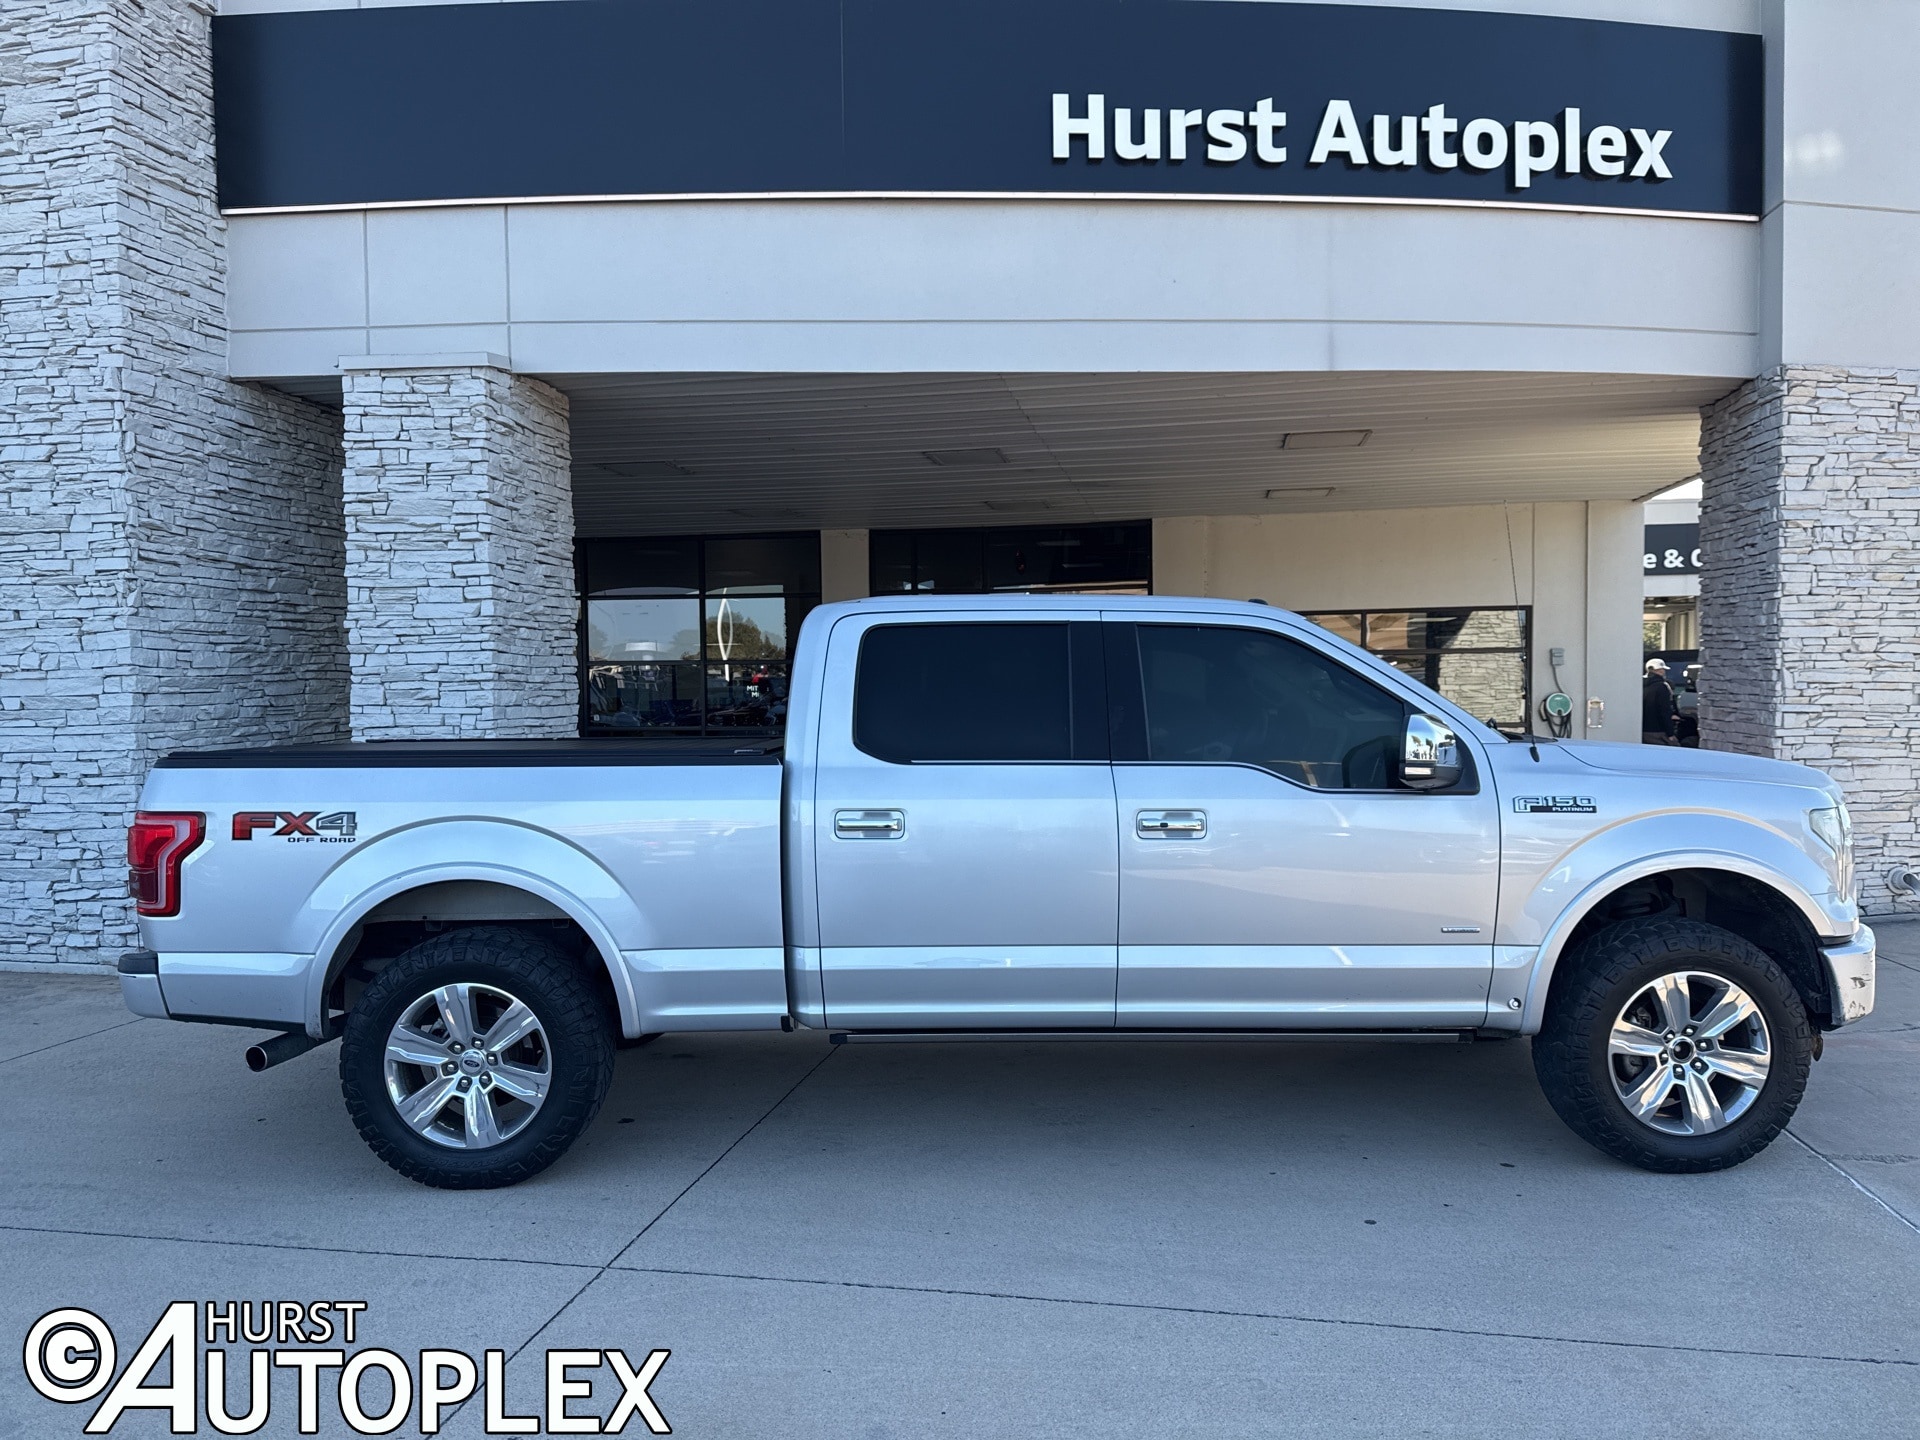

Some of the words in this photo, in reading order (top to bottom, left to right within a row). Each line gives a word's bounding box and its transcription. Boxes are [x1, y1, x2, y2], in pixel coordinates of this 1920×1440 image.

[1052, 93, 1287, 163] Hurst
[1310, 99, 1673, 188] Autoplex
[1664, 549, 1685, 568] &
[231, 811, 358, 841] FX4
